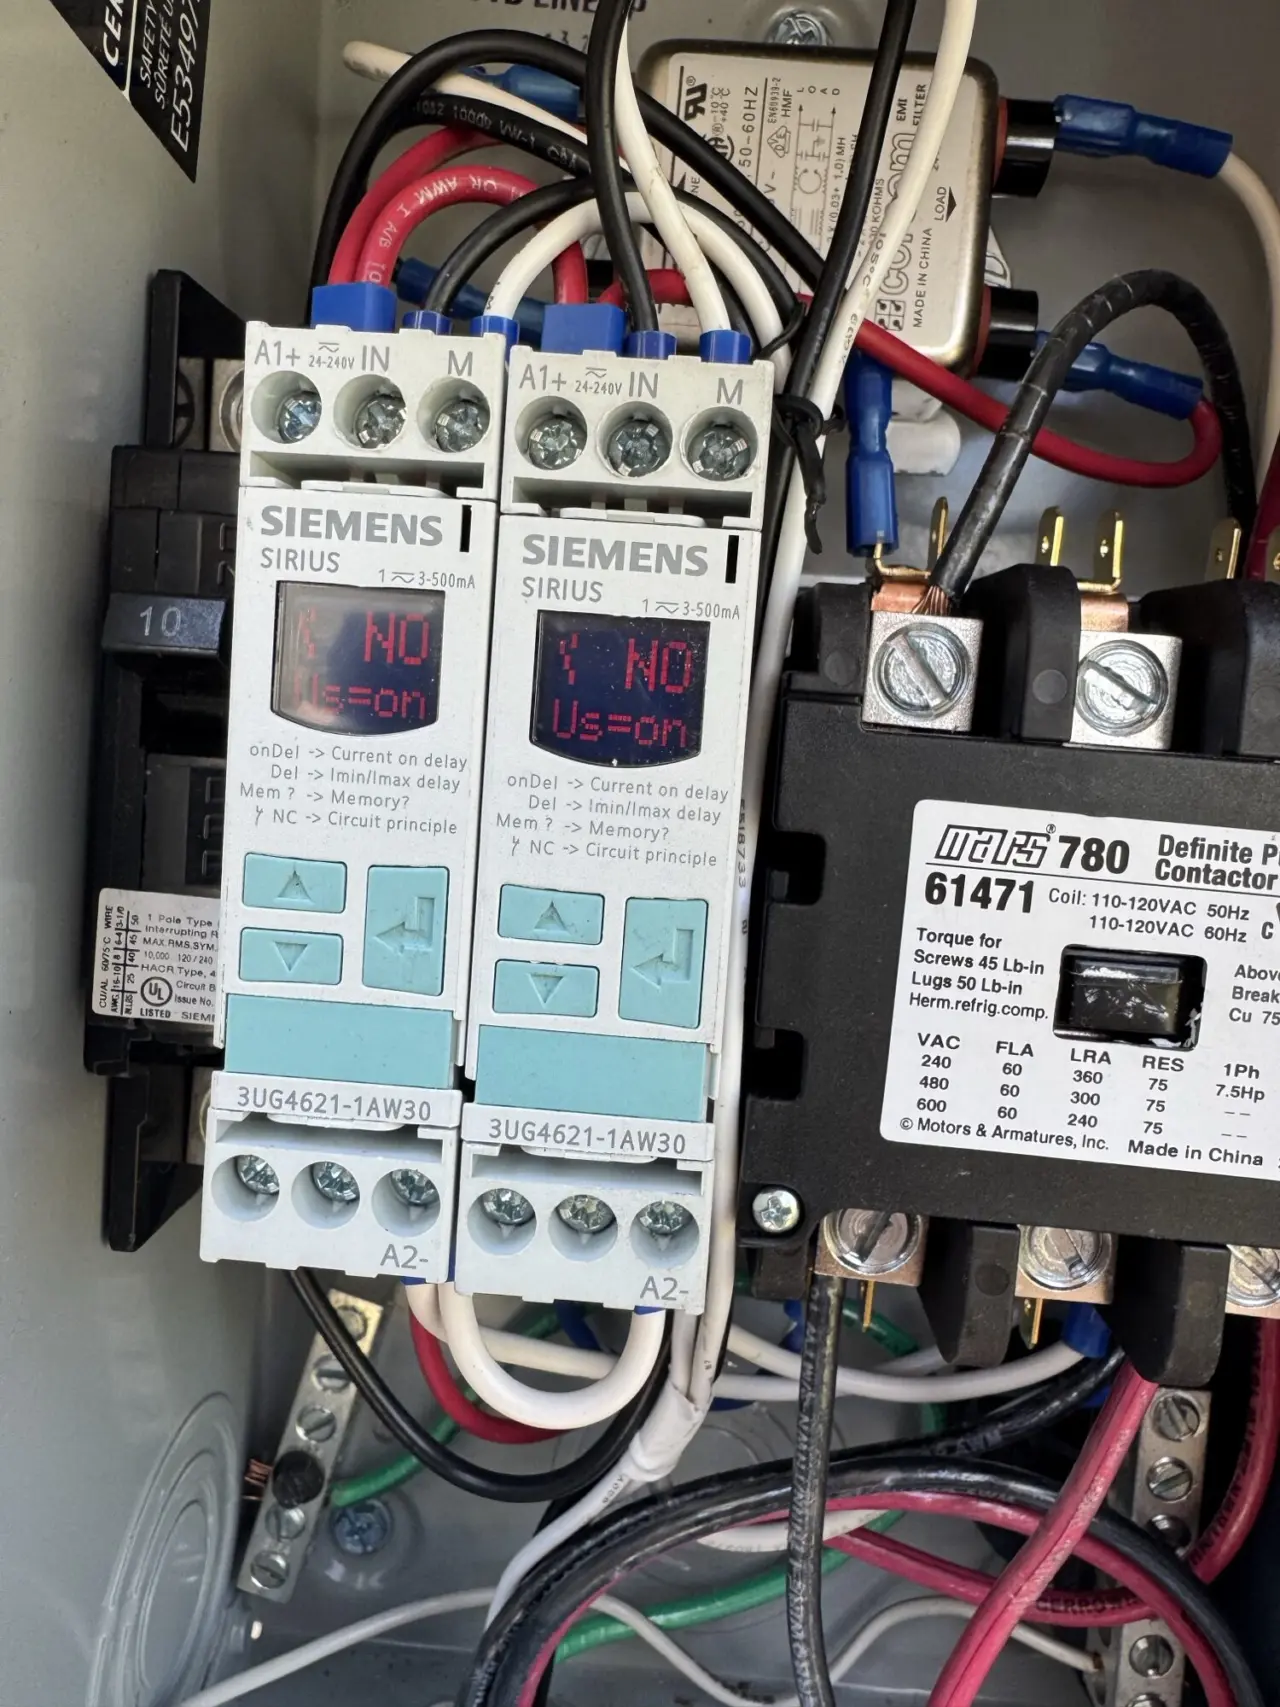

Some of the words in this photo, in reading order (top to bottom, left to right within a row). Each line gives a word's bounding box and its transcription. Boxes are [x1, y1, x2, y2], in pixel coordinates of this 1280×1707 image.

[140, 0, 157, 88] SAFETY
[896, 98, 908, 122] EMI
[414, 176, 459, 205] AWM
[934, 186, 947, 221] LOAD
[919, 227, 933, 269] CHINA
[918, 273, 928, 284] IN
[913, 289, 928, 328] MADE
[254, 339, 301, 367] A1+
[308, 355, 355, 371] 24-240V
[361, 345, 390, 373] IN
[447, 350, 473, 377] M
[519, 363, 567, 392] A1+
[575, 379, 623, 395] 24-240V
[628, 371, 659, 399] IN
[716, 377, 743, 405] M
[260, 505, 443, 547] SIEMENS
[260, 548, 341, 573] SIRIUS
[522, 533, 709, 577] SIEMENS
[418, 571, 475, 589] 3-500mA
[521, 576, 604, 603] SIRIUS
[140, 606, 181, 637] 10
[682, 601, 741, 620] 3-500mA
[364, 610, 430, 666] NO
[624, 637, 693, 694] NO
[249, 743, 299, 760] onDel
[331, 745, 393, 765] Current
[398, 753, 418, 766] on
[424, 752, 467, 772] delay
[270, 764, 299, 780] Del
[416, 776, 461, 794] delay
[507, 773, 558, 790] onDel
[590, 776, 653, 796] Current
[658, 784, 678, 798] on
[685, 784, 729, 802] delay
[331, 789, 410, 811] Memory?
[528, 794, 556, 810] Del
[676, 806, 721, 826] delay
[273, 808, 298, 825] NC
[328, 811, 382, 829] Circuit
[386, 817, 458, 837] principle
[589, 820, 669, 842] Memory?
[529, 839, 555, 855] NC
[586, 842, 640, 861] Circuit
[645, 848, 717, 868] principle
[1058, 835, 1130, 875] 780
[1159, 834, 1253, 864] Definite
[1155, 858, 1279, 891] Contactor
[925, 872, 1034, 914] 61471
[1048, 887, 1087, 906] Coil:
[1092, 893, 1197, 916] 110-120VAC
[1206, 903, 1250, 921] 50Hz
[145, 925, 207, 938] Interrupting
[158, 914, 182, 924] Pole
[186, 917, 213, 927] Type
[1089, 915, 1194, 938] 110-120VAC
[1204, 926, 1247, 943] 60Hz
[916, 927, 974, 948] Torque
[980, 932, 1003, 948] for
[140, 964, 174, 974] HACR
[913, 949, 974, 968] Screws
[978, 955, 998, 971] 45
[1003, 956, 1044, 975] Lb-in
[1234, 964, 1280, 982] Abov
[176, 980, 206, 990] Circuit
[911, 971, 952, 990] Lugs
[956, 975, 977, 991] 50
[981, 976, 1023, 996] Lb-in
[140, 1008, 171, 1019] LISTED
[174, 995, 198, 1005] Issue
[199, 997, 214, 1008] No.
[1228, 1007, 1252, 1023] Cu
[917, 1032, 961, 1051] VAC
[995, 1040, 1035, 1058] FLA
[1070, 1048, 1112, 1066] LRA
[1142, 1055, 1184, 1073] RES
[1224, 1063, 1260, 1080] 1Ph
[921, 1054, 952, 1069] 240
[1002, 1062, 1023, 1077] 60
[1072, 1069, 1104, 1085] 360
[1148, 1077, 1168, 1092] 75
[1215, 1083, 1265, 1104] 7.5Hp
[237, 1086, 431, 1121] 3UG4621-1AW30
[919, 1076, 950, 1091] 480
[999, 1083, 1020, 1098] 60
[1070, 1091, 1101, 1107] 300
[1146, 1098, 1166, 1113] 75
[916, 1098, 947, 1113] 600
[997, 1105, 1018, 1120] 60
[1067, 1113, 1098, 1129] 240
[1143, 1120, 1163, 1135] 75
[488, 1118, 686, 1154] 3UG4621-1AW30
[917, 1118, 972, 1137] Motors
[975, 1122, 988, 1138] &
[991, 1124, 1078, 1150] Armatures,
[1082, 1134, 1110, 1151] Inc.
[1127, 1139, 1179, 1159] Made
[1185, 1145, 1202, 1160] in
[1208, 1147, 1264, 1166] China
[379, 1243, 429, 1270] A2-
[639, 1275, 690, 1301] A2-
